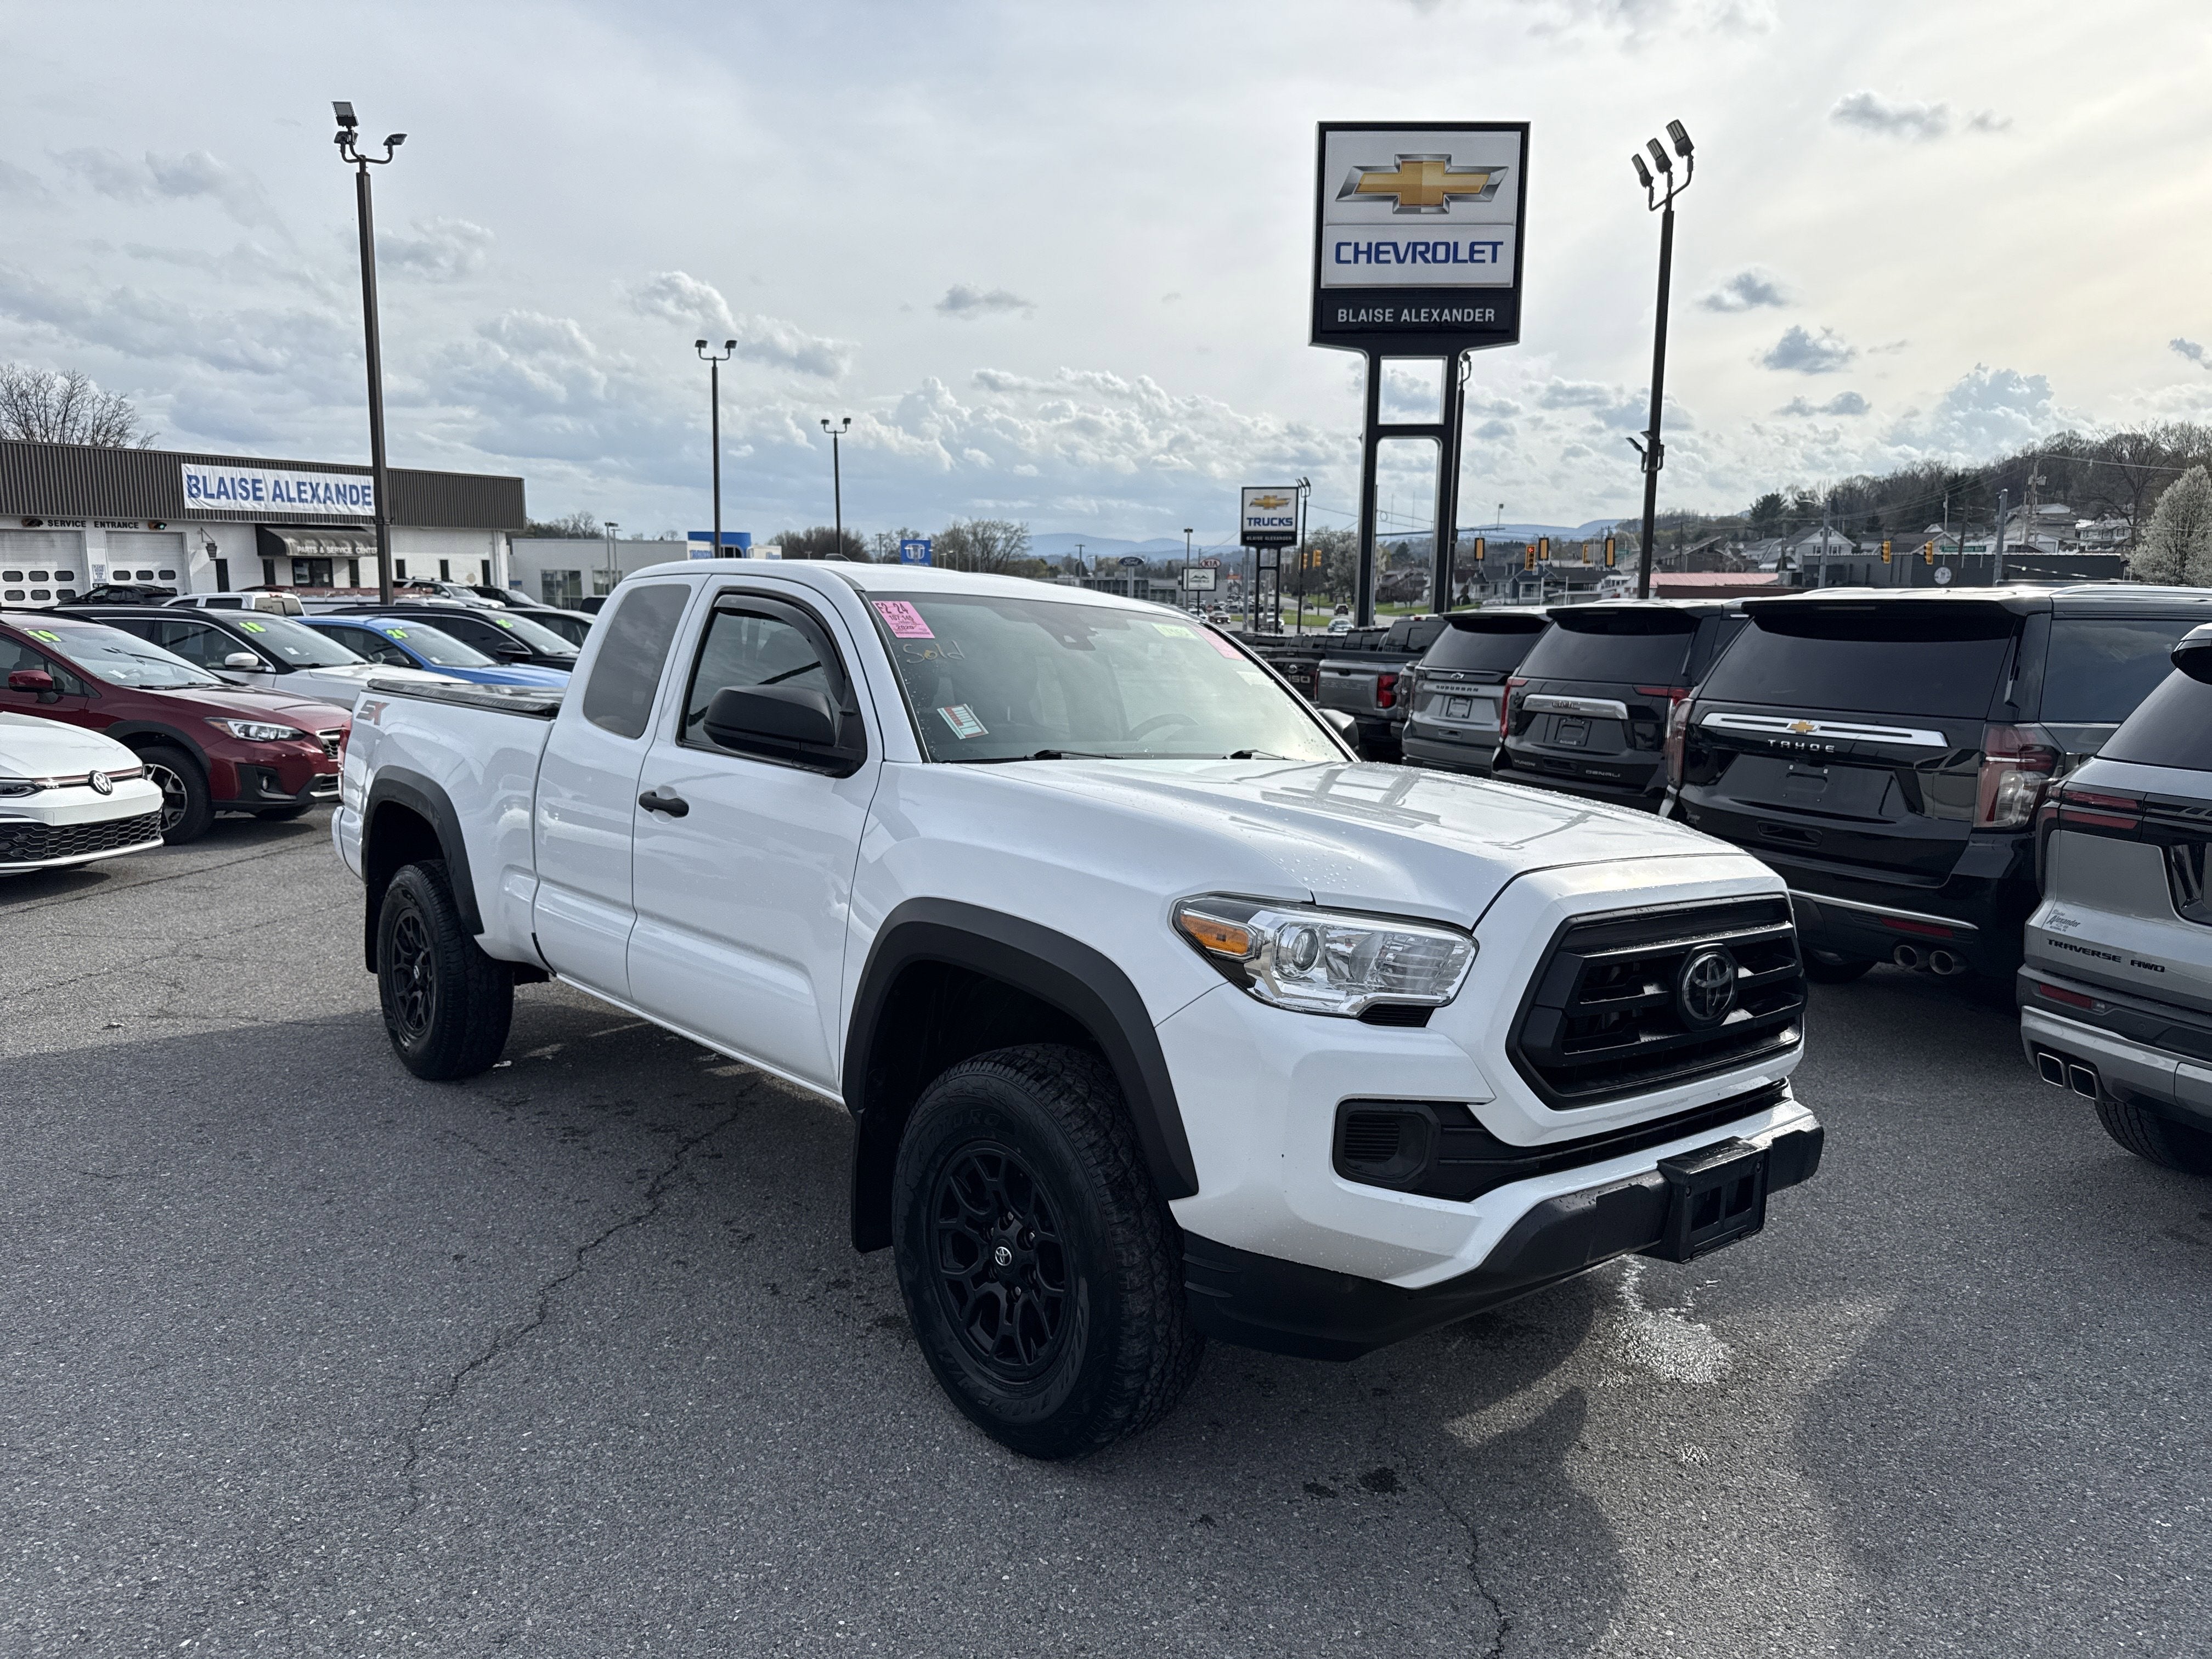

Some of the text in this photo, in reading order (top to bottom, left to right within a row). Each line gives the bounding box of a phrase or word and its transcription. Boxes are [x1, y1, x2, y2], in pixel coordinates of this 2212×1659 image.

[1335, 241, 1503, 264] CHEVROLET
[1338, 308, 1495, 323] BLAISE ALEXANDER
[187, 475, 373, 506] BLAISE ALEXANDE
[48, 520, 139, 529] SERVICE ENTRANCE
[1246, 517, 1293, 527] TRUCKS
[326, 546, 353, 554] SERVICE
[894, 602, 909, 614] 24
[903, 640, 966, 663] Sold
[1551, 700, 1581, 710] GMC
[1768, 739, 1835, 753] TAHOE
[1514, 759, 1536, 767] YUKON
[1585, 769, 1621, 778] DENALI
[2046, 915, 2081, 928] Alexander
[2047, 938, 2166, 973] TRAVERSE AWD
